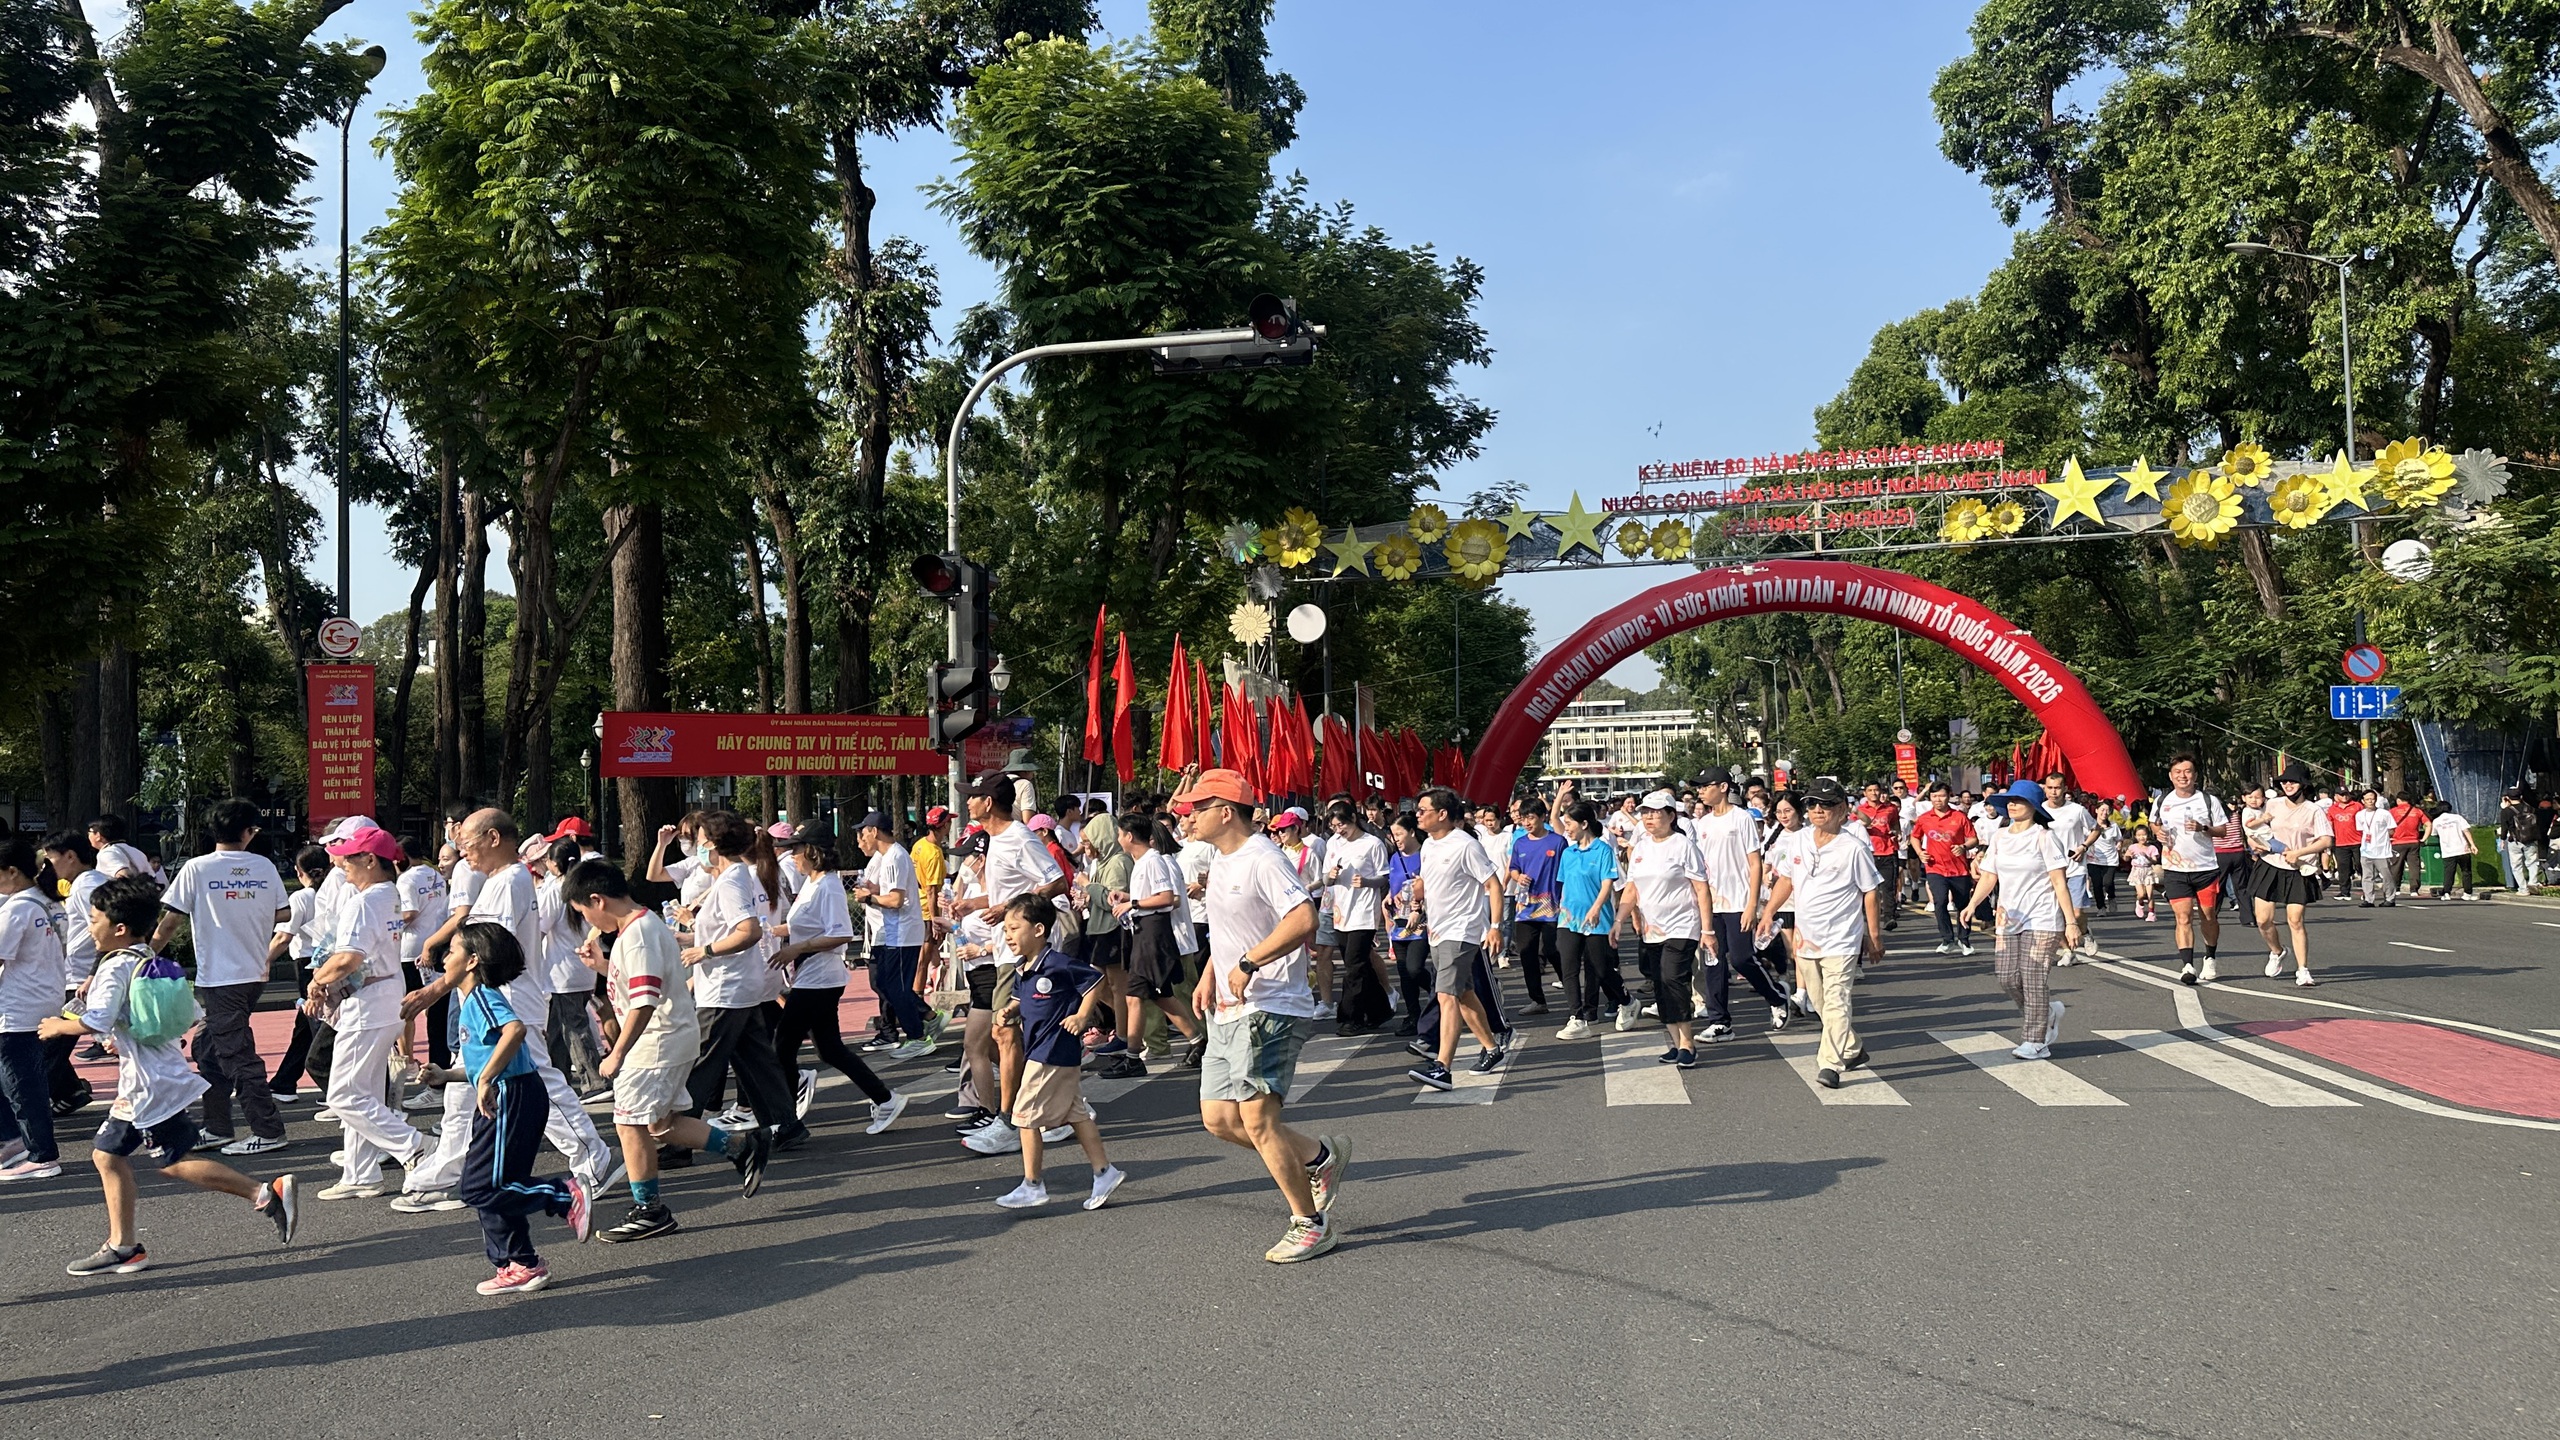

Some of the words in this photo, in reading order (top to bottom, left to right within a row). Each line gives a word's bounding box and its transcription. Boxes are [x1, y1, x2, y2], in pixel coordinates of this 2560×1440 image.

[1638, 459, 1666, 481] KỶ
[1672, 459, 1719, 480] NIỆM
[1724, 457, 1746, 475] 80
[1752, 452, 1798, 475] NĂM
[1804, 446, 1861, 468] NGÀY
[1866, 443, 1927, 464] QUỐC
[1601, 491, 1658, 512] NƯỚC
[1662, 490, 1718, 511] CỘNG
[1722, 484, 1766, 505] HÒA
[1768, 482, 1798, 501] XÃ
[1801, 480, 1836, 502] HỘI
[1840, 475, 1882, 497] CHỦ
[1886, 473, 1950, 493] NGHĨA
[1951, 471, 1996, 491] VIỆT
[1999, 469, 2047, 486] NAM
[1523, 680, 1566, 724] NGÀY
[1552, 652, 1595, 692] CHẠY
[1586, 614, 1653, 666] OLYMPIC
[1653, 599, 1675, 628] VÌ
[1673, 591, 1707, 623] SỨC
[1706, 577, 1749, 613] KHỎE
[1752, 575, 1798, 606] TOÀN
[1800, 575, 1835, 604] DÂN
[1844, 578, 1862, 607] VÌ
[1859, 585, 1889, 613] AN
[1885, 590, 1933, 626] NINH
[1927, 601, 1959, 632] TỔ
[1948, 613, 1994, 652] QUỐC
[1983, 635, 2032, 676] NĂM
[2015, 662, 2064, 704] 2026
[321, 714, 337, 723] RÈN
[339, 713, 362, 724] LUYỆN
[324, 727, 344, 736] THÂN
[312, 739, 328, 749] BẢO
[329, 739, 339, 750] VỆ
[340, 738, 350, 749] TỔ
[351, 738, 372, 748] QUỐC
[717, 732, 743, 750] HÃY
[747, 735, 792, 750] CHUNG
[795, 736, 817, 750] TAY
[819, 733, 831, 750] VÌ
[835, 730, 859, 750] THỂ
[861, 734, 887, 753] LỰC,
[890, 732, 916, 750] TẦM
[322, 752, 338, 761] RÈN
[339, 752, 363, 762] LUYỆN
[766, 756, 793, 771] CON
[796, 754, 836, 771] NGƯỜI
[839, 755, 865, 773] VIỆT
[868, 756, 897, 771] NAM
[325, 765, 345, 774] THÂN
[322, 777, 340, 787] KIẾN
[342, 776, 362, 787] THIẾT
[324, 790, 339, 800] ĐẤT
[340, 789, 361, 799] NƯỚC
[208, 880, 268, 890] OLYMPIC
[225, 890, 256, 900] RUN
